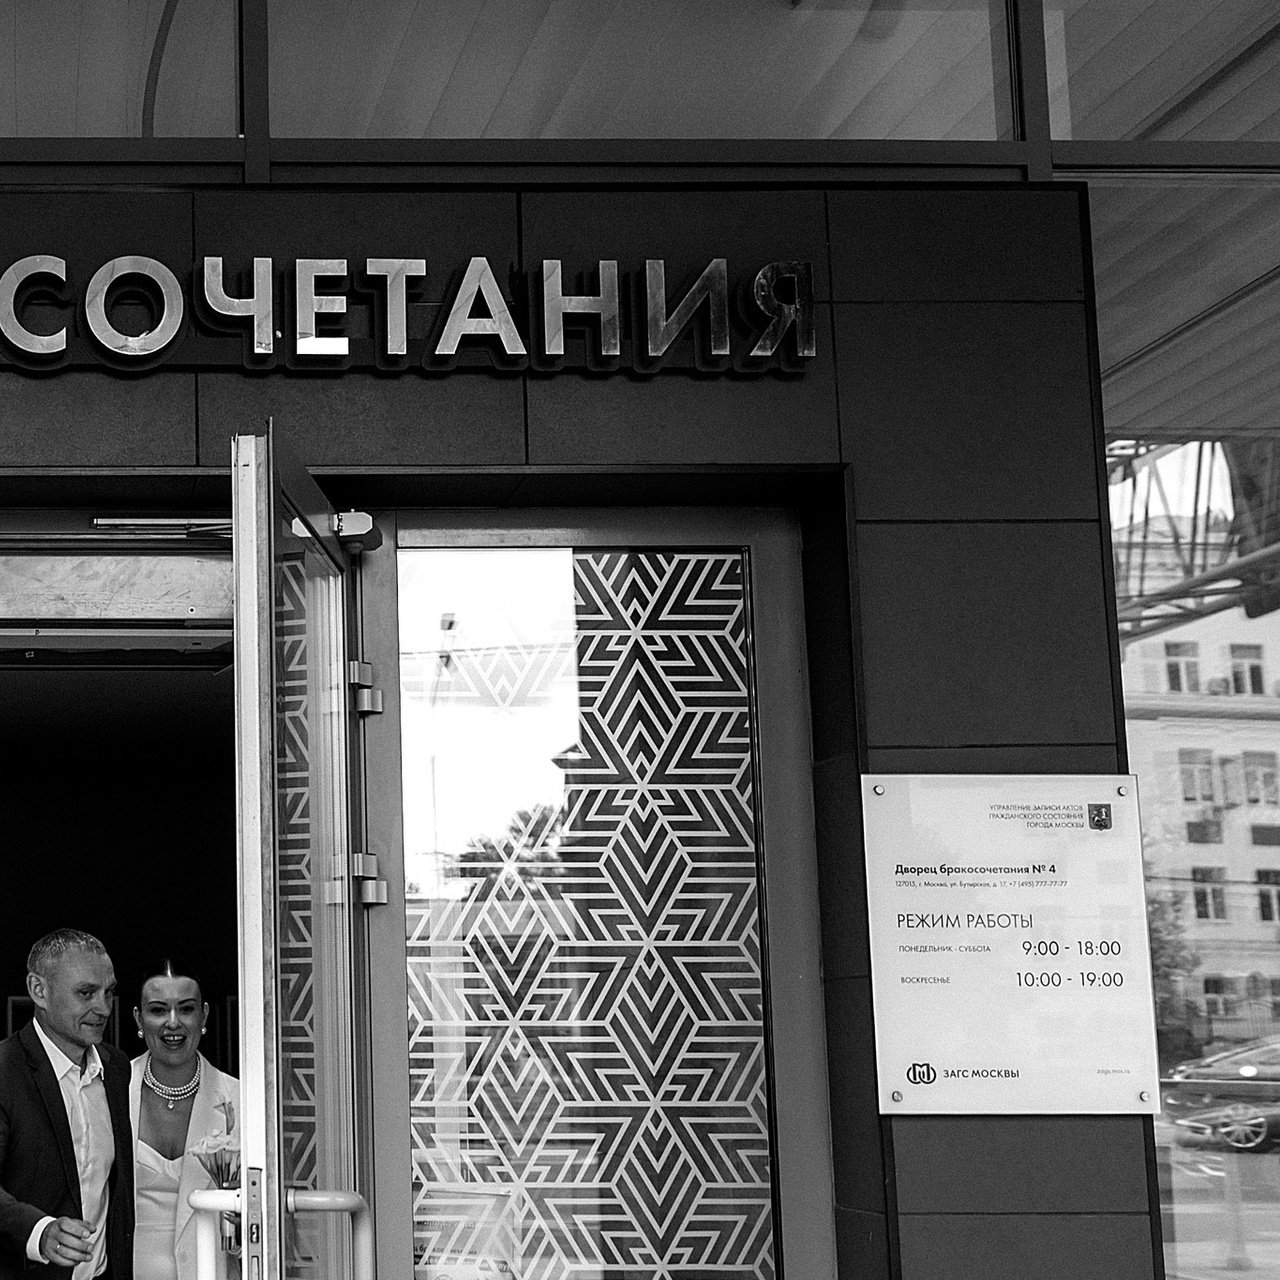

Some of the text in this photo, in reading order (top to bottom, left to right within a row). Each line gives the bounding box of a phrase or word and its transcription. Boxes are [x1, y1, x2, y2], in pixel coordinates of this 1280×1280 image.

[1026, 821, 1085, 829] ГОРОДА МОСКВЫ
[894, 864, 938, 877] Дворец
[939, 863, 1030, 876] бракосочетания
[1048, 864, 1057, 874] 4
[896, 913, 1034, 929] РЕЖИМ РАБОТЫ
[898, 945, 954, 953] ПОНЕДЕЛЬНИК
[958, 945, 991, 953] СУББОТА
[1021, 940, 1060, 956] 9:00
[1076, 940, 1122, 956] 18:00
[900, 976, 951, 985] ВОСКРЕСЕНЬЕ
[1016, 972, 1062, 988] 10:00
[1079, 972, 1124, 988] 19:00
[942, 1069, 1021, 1079] ЗАГС МОСКВЫ
